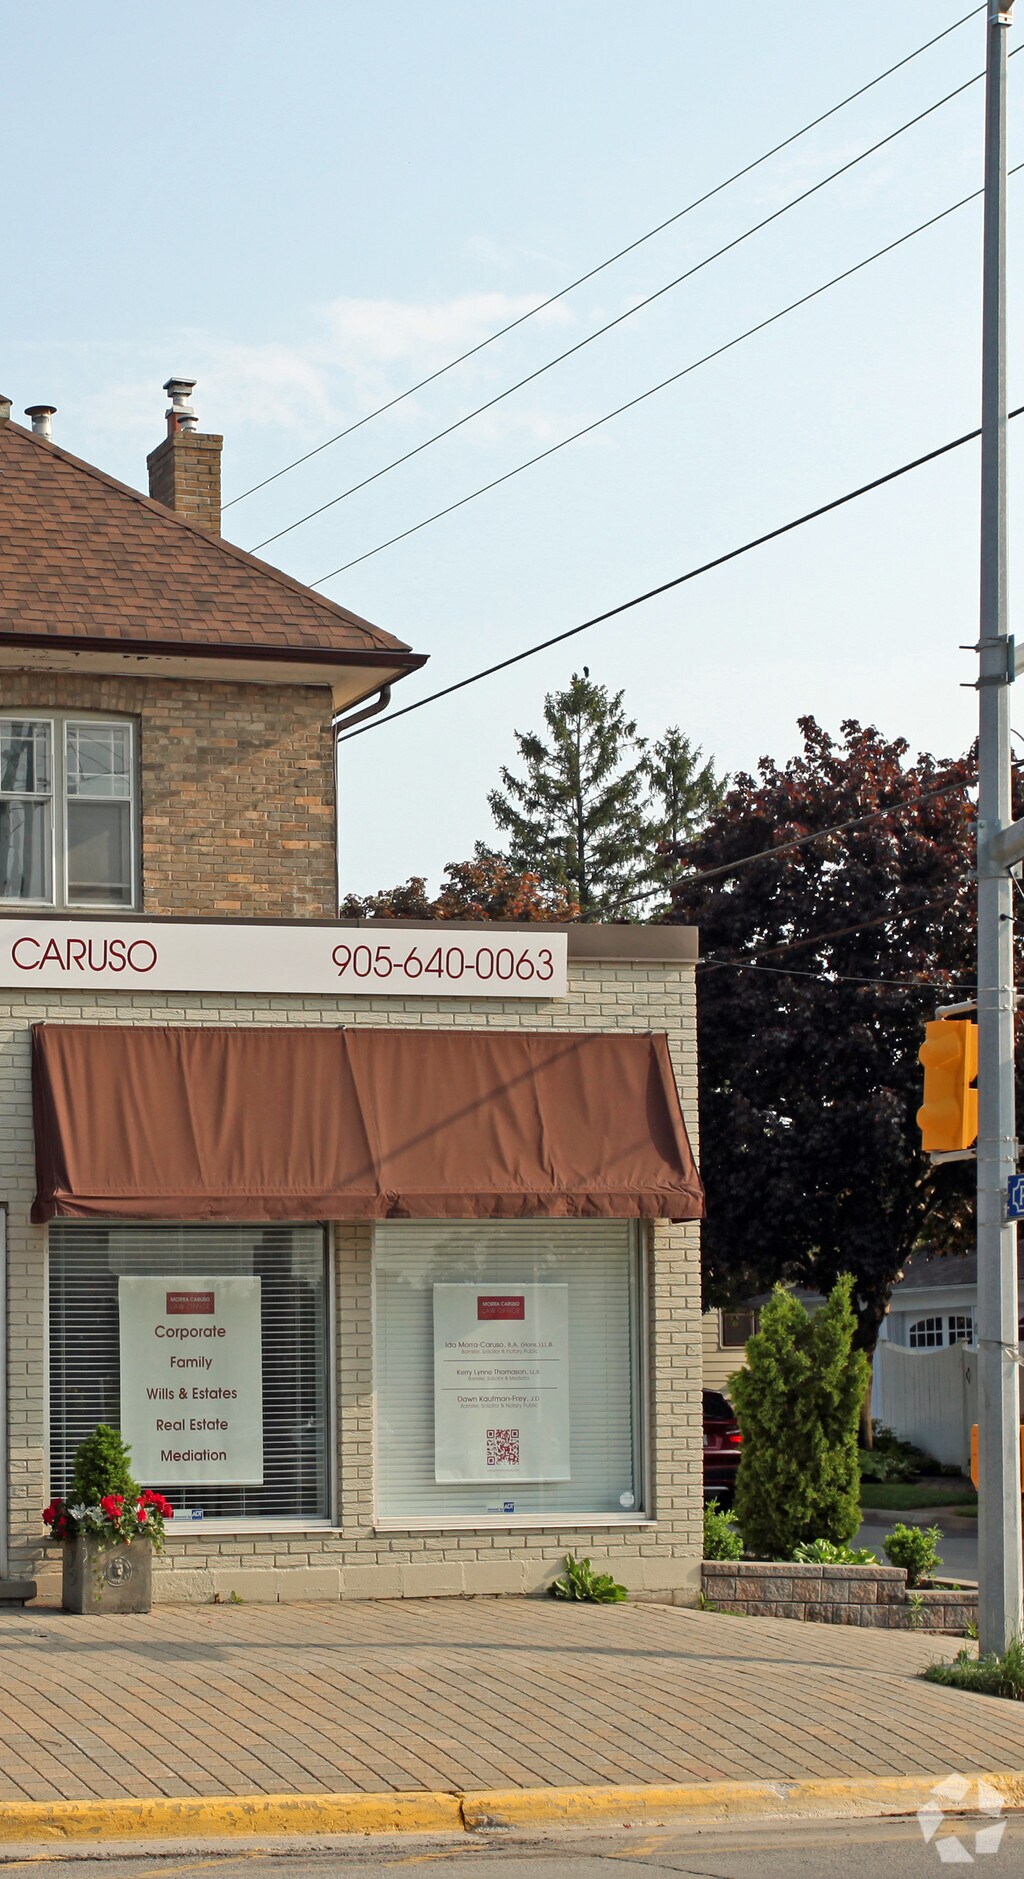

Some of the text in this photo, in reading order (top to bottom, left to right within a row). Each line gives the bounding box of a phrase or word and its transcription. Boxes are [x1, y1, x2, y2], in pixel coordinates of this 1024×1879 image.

[11, 936, 158, 973] CARUSO
[332, 944, 554, 980] 905-640-0063
[154, 1325, 226, 1340] Corporate
[170, 1356, 213, 1370] Family
[146, 1387, 238, 1399] Wills & Estates
[156, 1418, 229, 1431] Real Estate
[161, 1449, 227, 1461] Mediation
